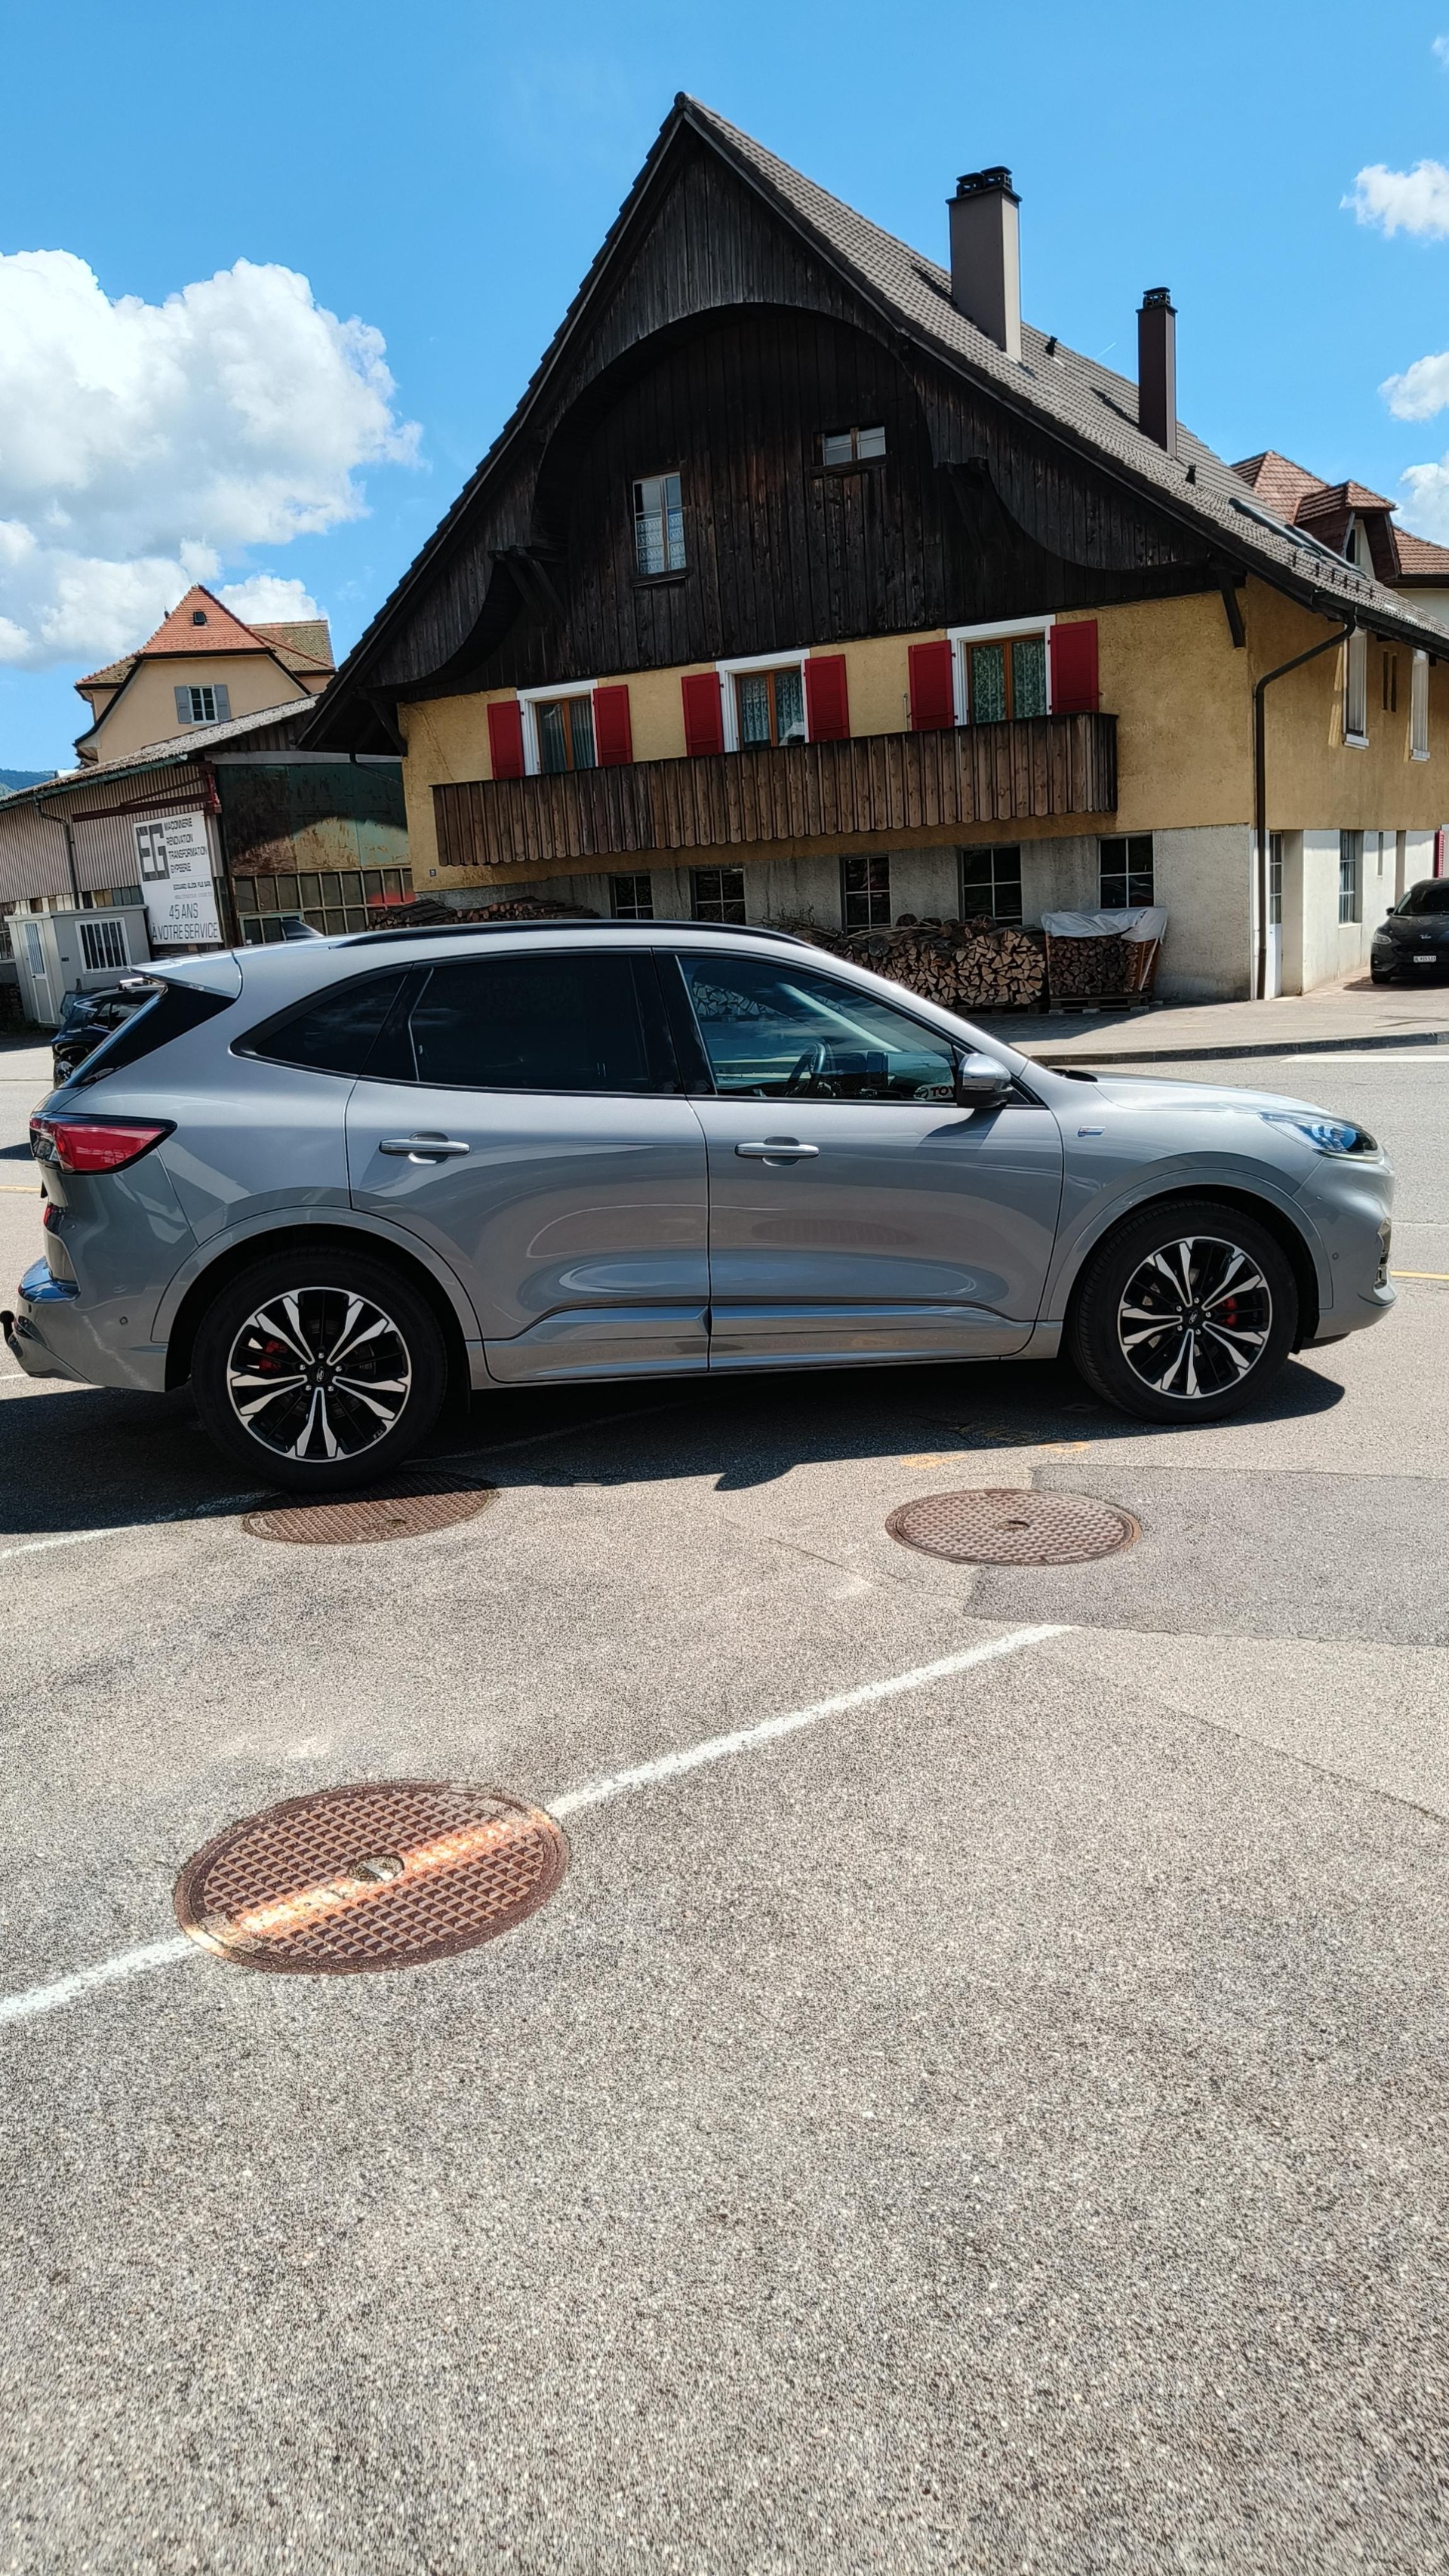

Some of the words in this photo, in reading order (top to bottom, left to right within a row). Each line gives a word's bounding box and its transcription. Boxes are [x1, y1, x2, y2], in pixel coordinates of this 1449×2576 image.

[136, 823, 170, 882] EG
[169, 904, 180, 919] 45
[181, 903, 198, 919] ANS
[158, 924, 183, 940] VOTRE
[184, 922, 218, 939] SERVICE
